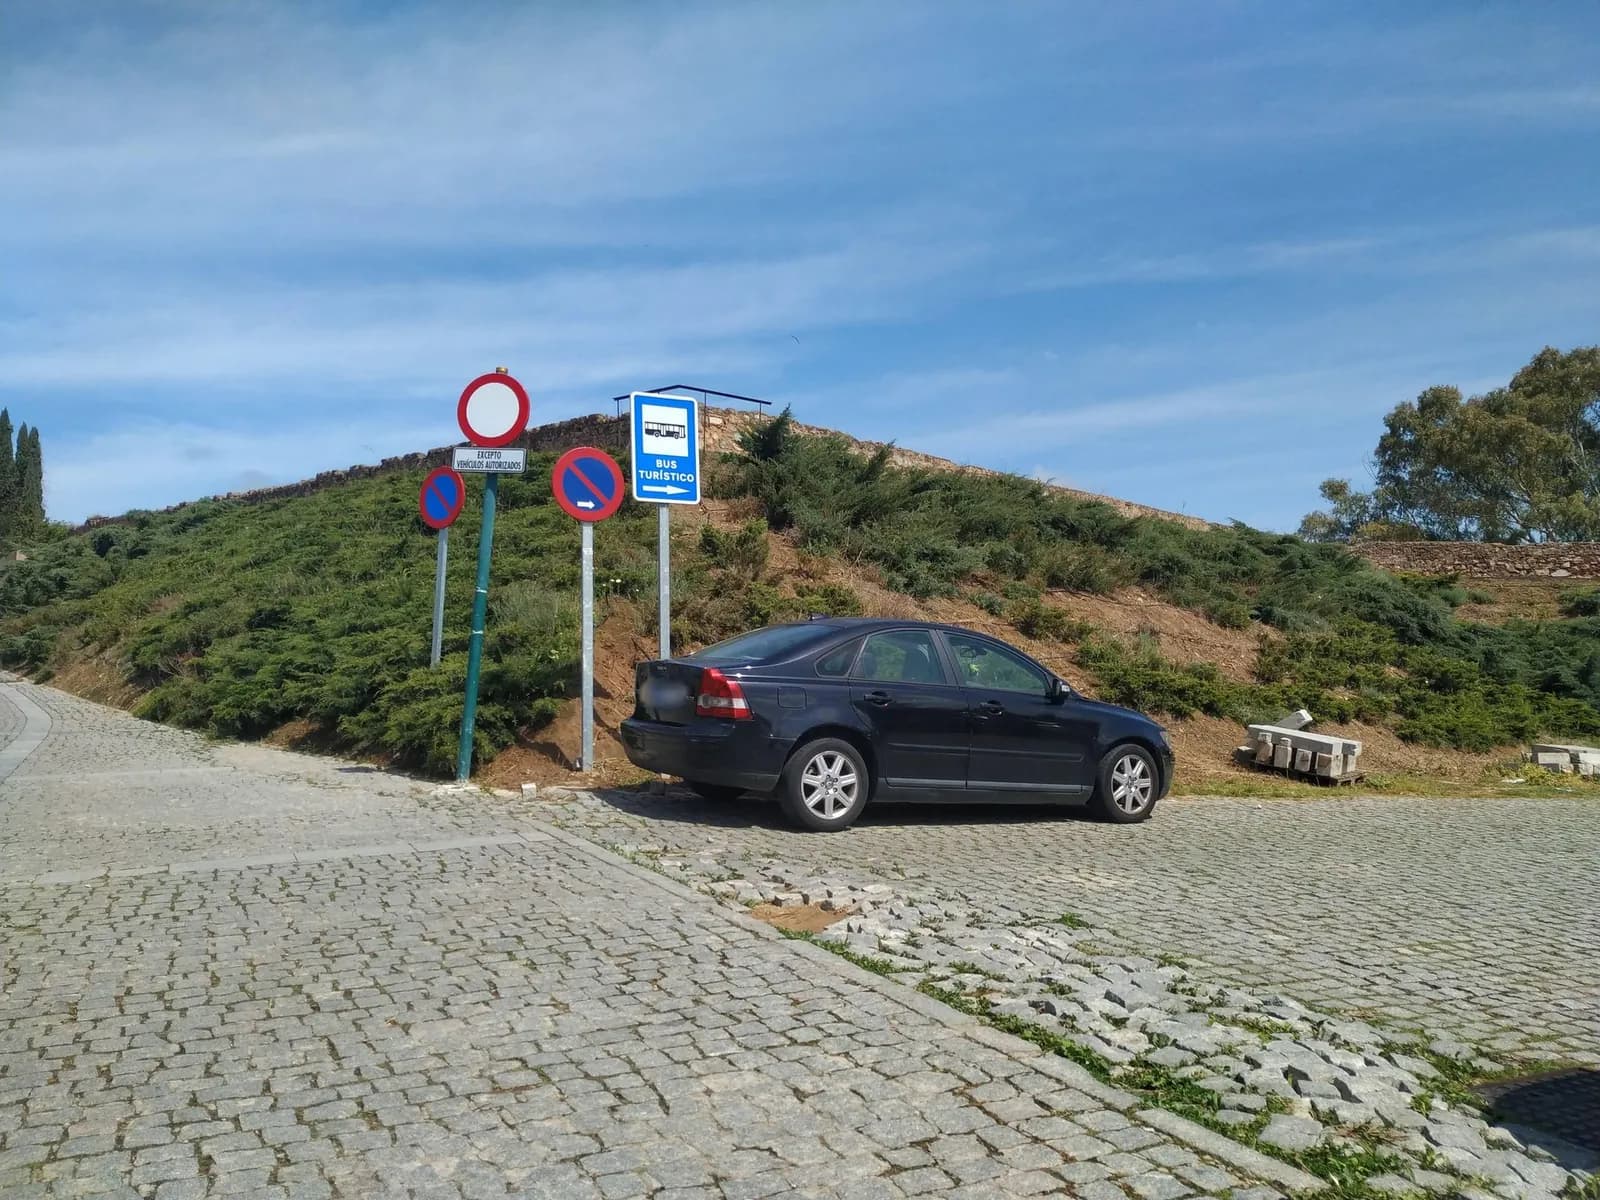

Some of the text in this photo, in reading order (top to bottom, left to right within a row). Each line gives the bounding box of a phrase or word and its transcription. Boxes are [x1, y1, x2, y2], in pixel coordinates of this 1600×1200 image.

[477, 451, 502, 460] EXCEPTO
[457, 458, 522, 470] VEHÍCULOS AUTORIZADOS
[656, 459, 677, 469] BUS
[638, 470, 695, 482] TURÍSTICO
